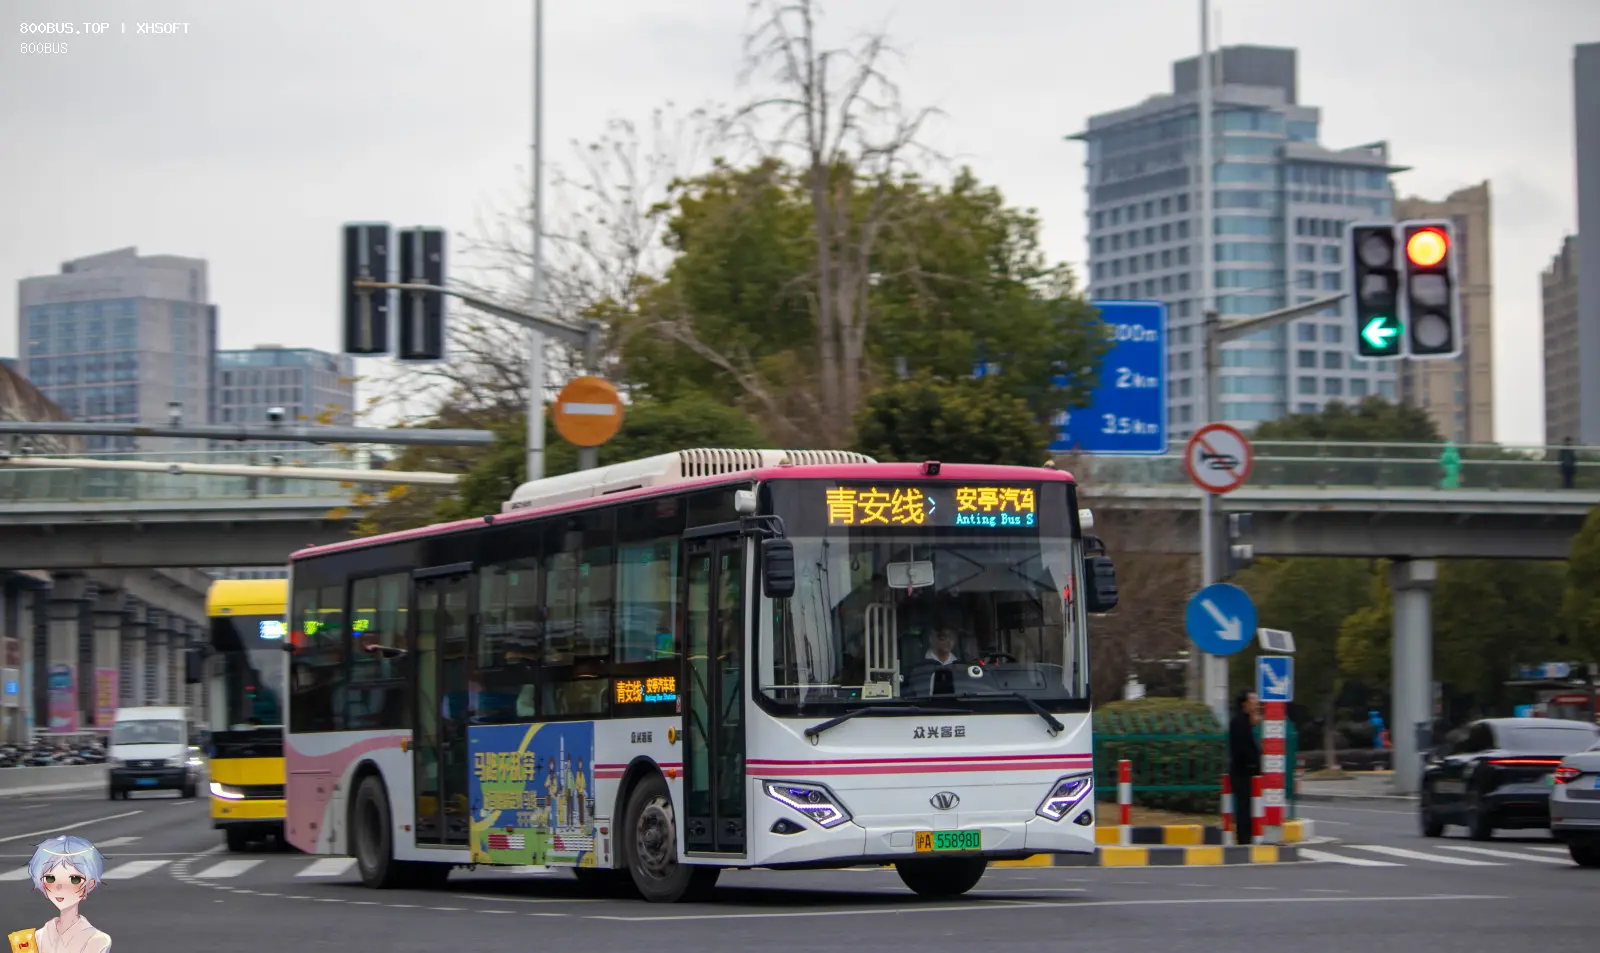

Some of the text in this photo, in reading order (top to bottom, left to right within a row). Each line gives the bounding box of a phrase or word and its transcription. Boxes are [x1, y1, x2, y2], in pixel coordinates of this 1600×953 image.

[1115, 367, 1159, 388] 2km
[826, 487, 925, 524] 青安线
[956, 513, 1034, 526] Anting Bus S
[616, 680, 643, 702] 青安线
[913, 726, 967, 739] 众兴客运
[917, 832, 980, 849] 沪A 55898D
